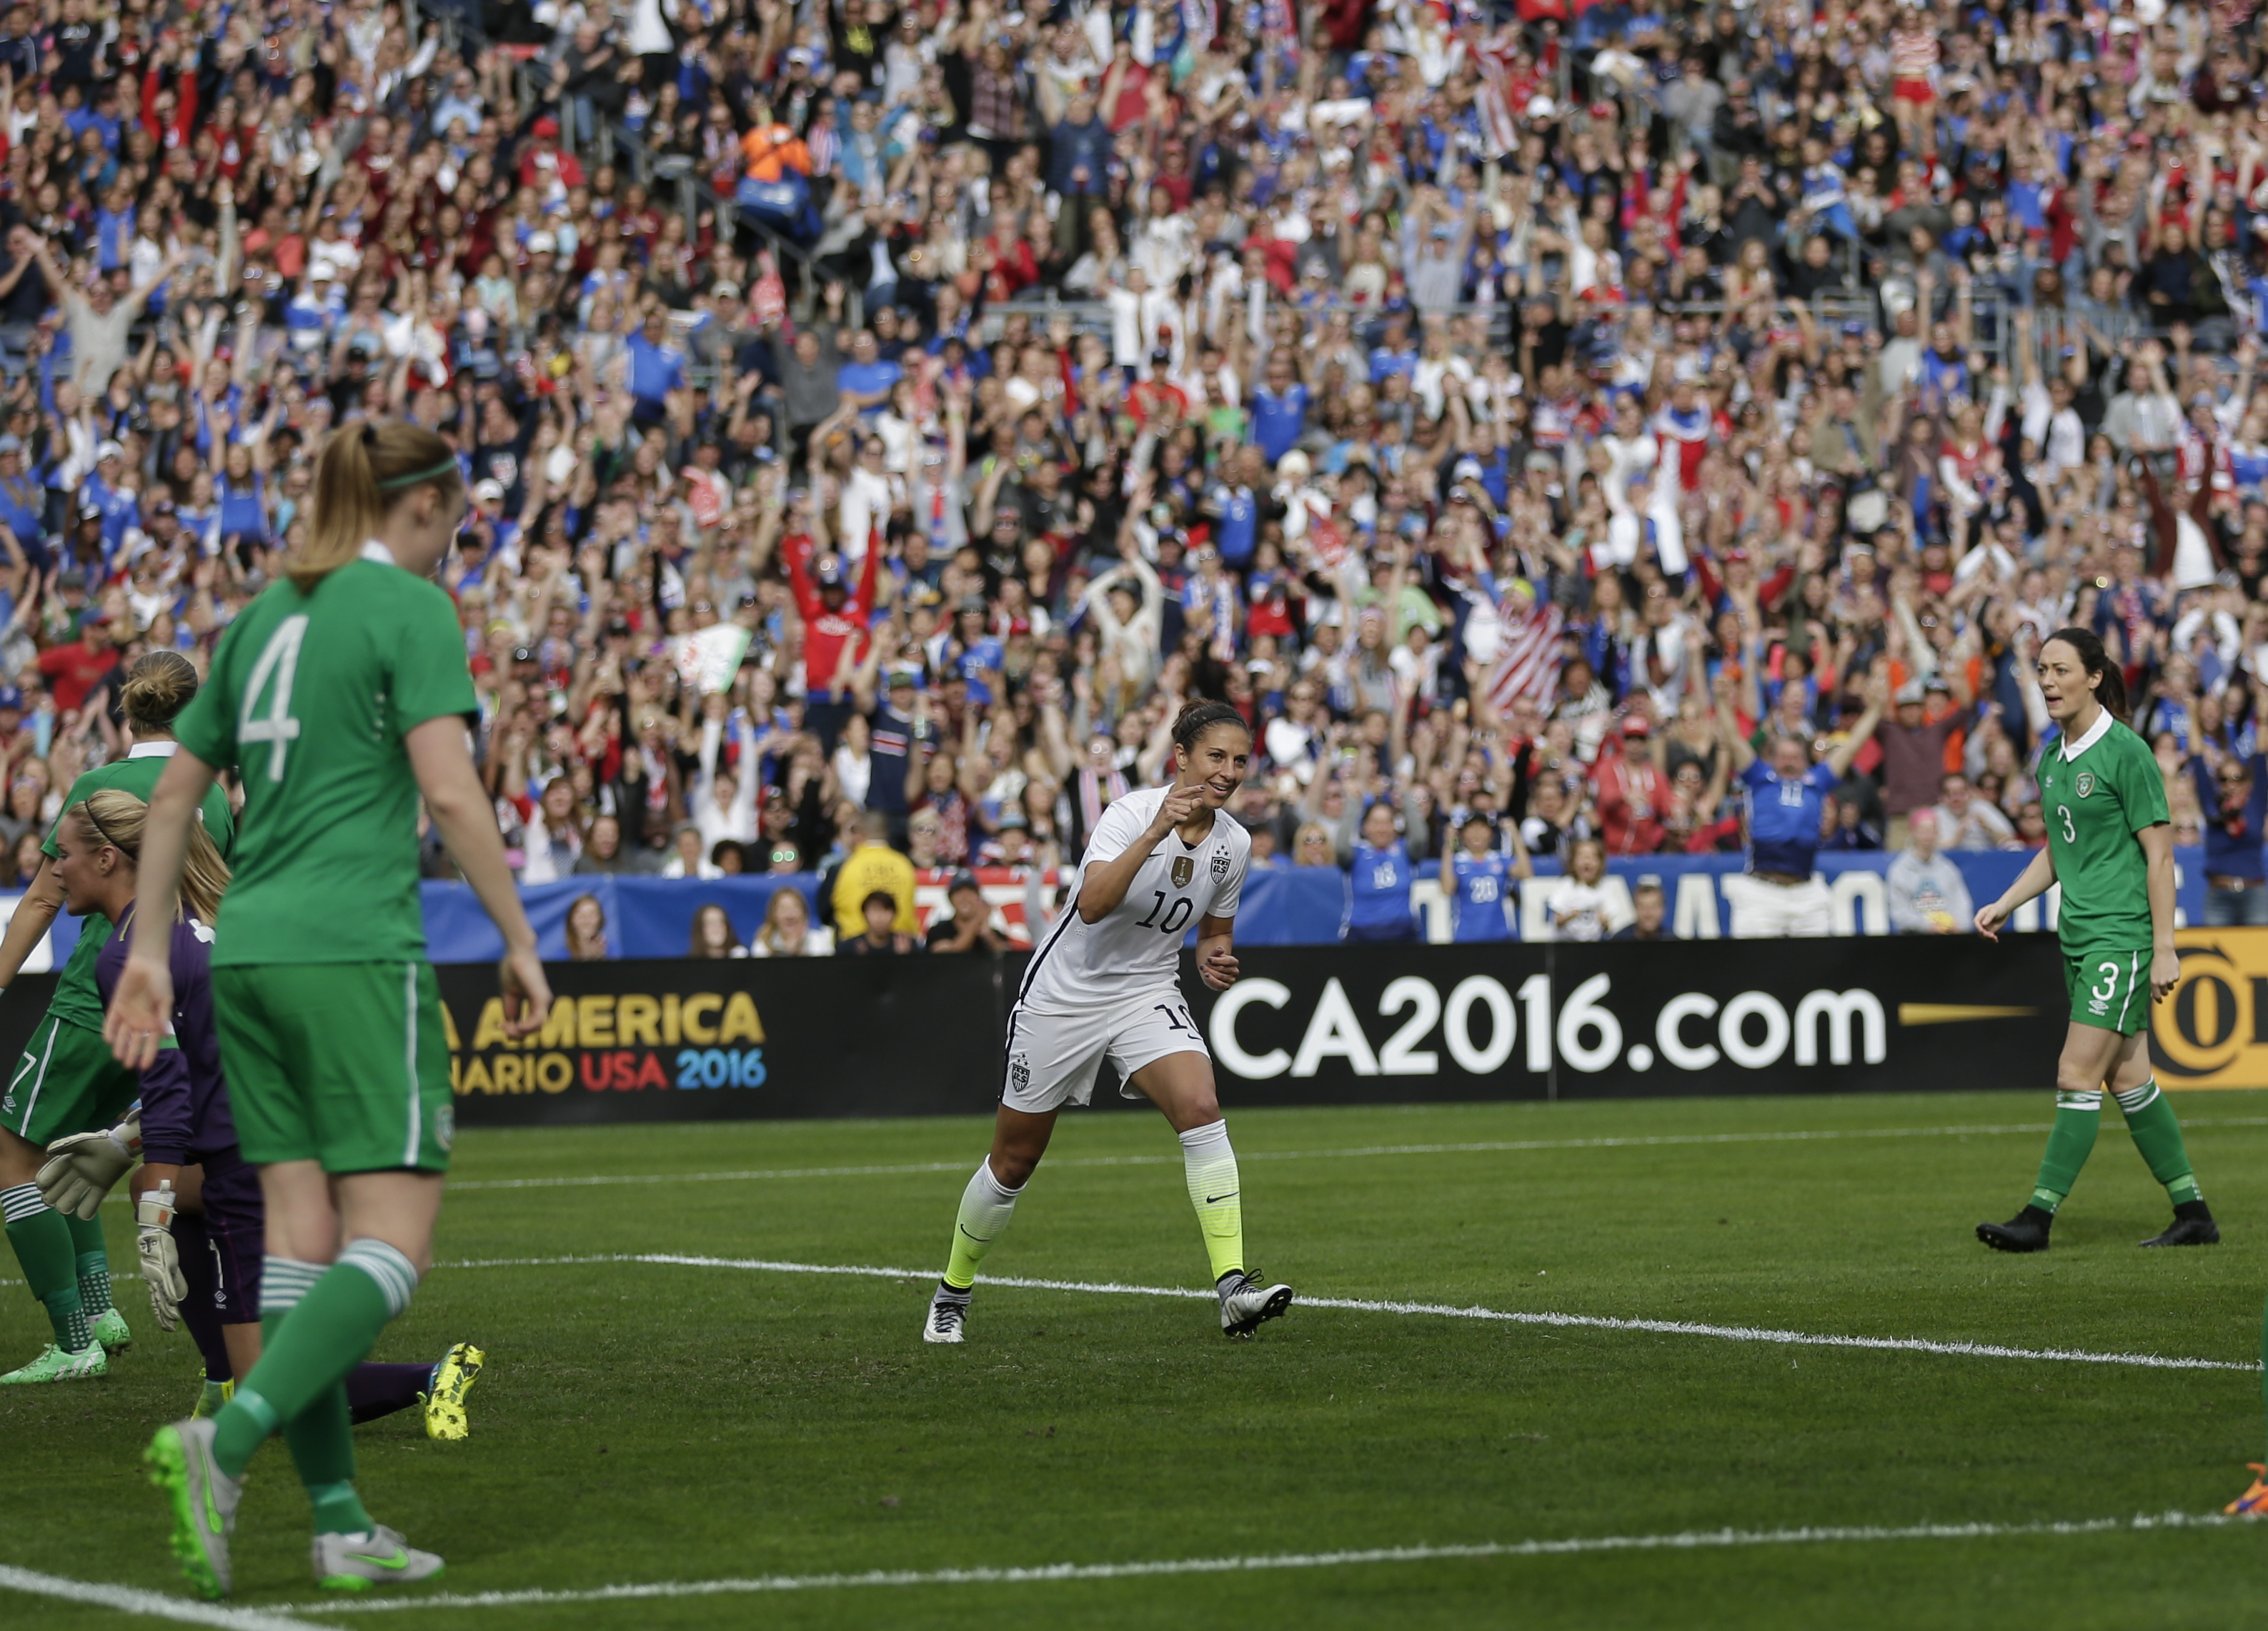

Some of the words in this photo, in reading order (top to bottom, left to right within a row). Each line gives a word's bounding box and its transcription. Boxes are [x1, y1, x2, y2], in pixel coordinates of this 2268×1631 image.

[237, 614, 309, 782] 4
[2057, 804, 2076, 844] 3
[1135, 890, 1194, 934] 10
[2092, 962, 2120, 1002] 3
[472, 991, 767, 1051] AMERICA
[1208, 972, 1888, 1079] CA2016.com
[9, 1051, 37, 1094] 7
[580, 1049, 670, 1092] USA
[675, 1047, 768, 1090] 2016
